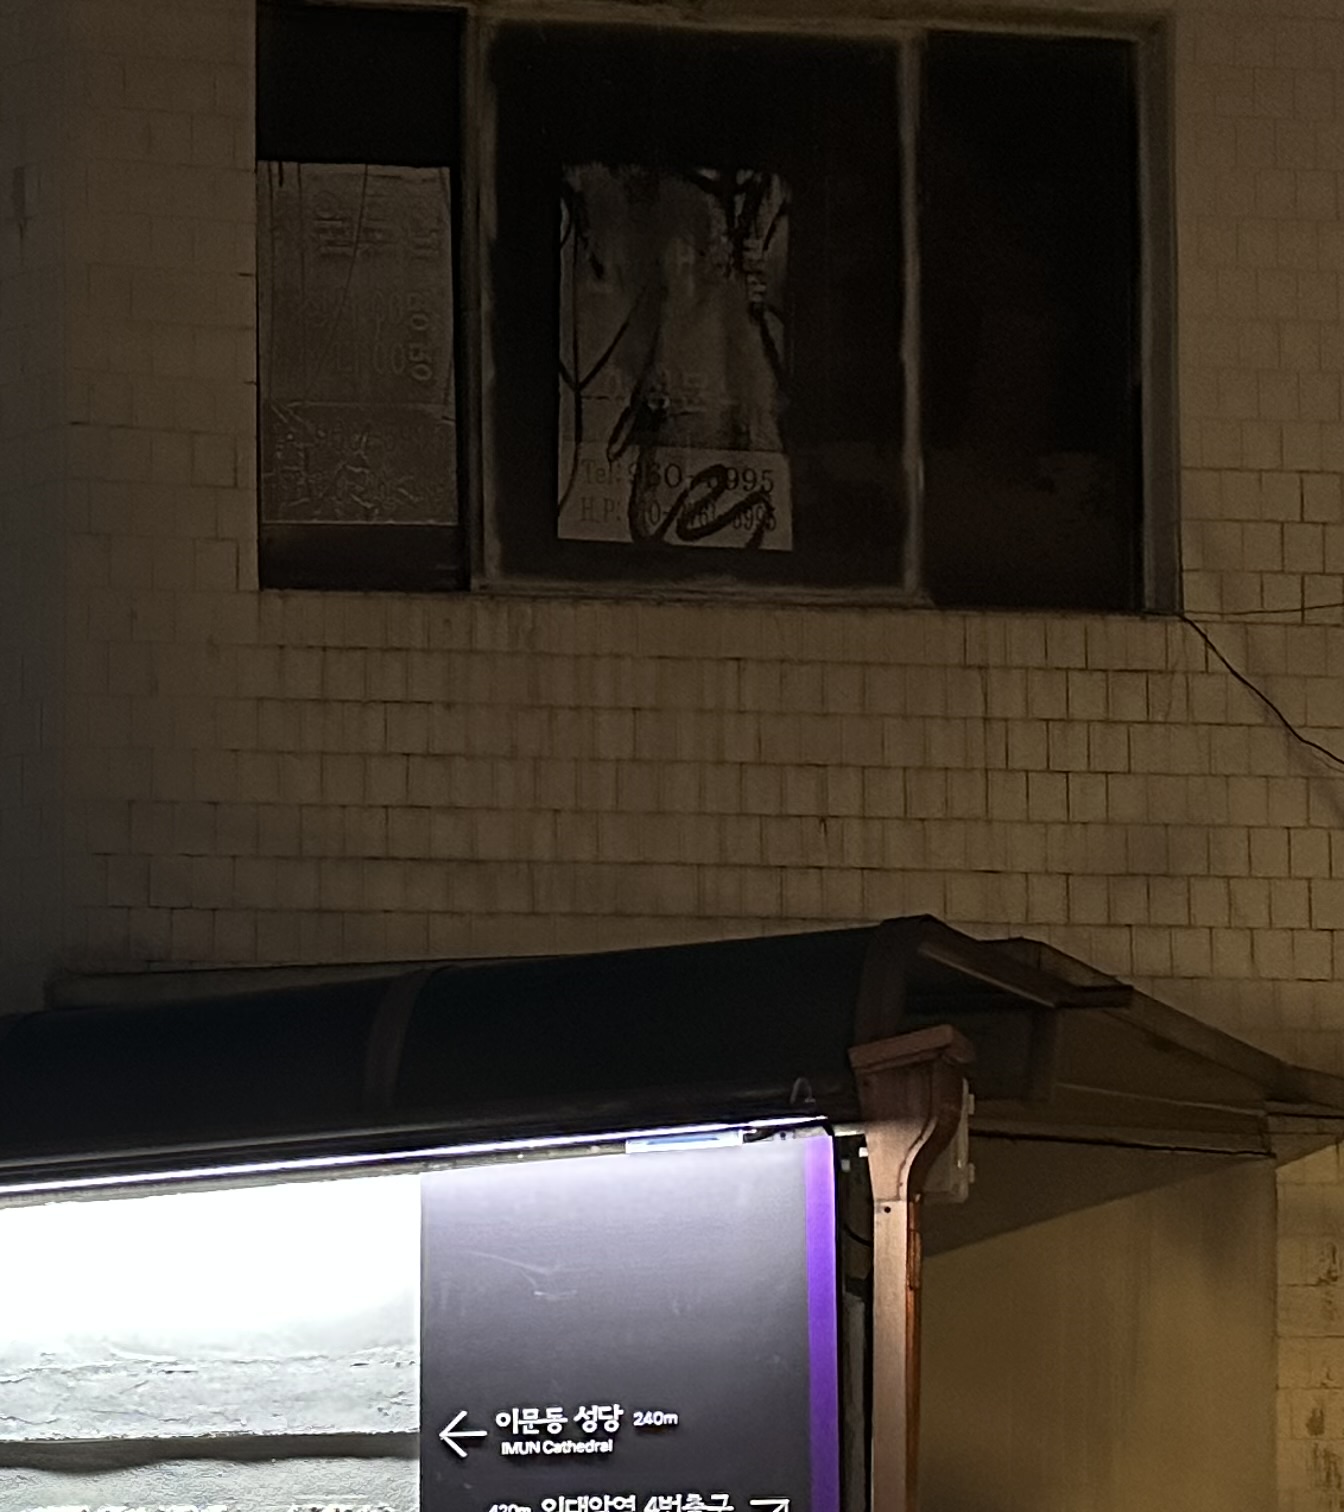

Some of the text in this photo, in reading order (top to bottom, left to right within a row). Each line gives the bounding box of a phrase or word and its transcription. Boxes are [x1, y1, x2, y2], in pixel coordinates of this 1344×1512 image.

[496, 1404, 678, 1434] 이문동 성당 240m
[502, 1439, 613, 1455] IMUN Cathedral
